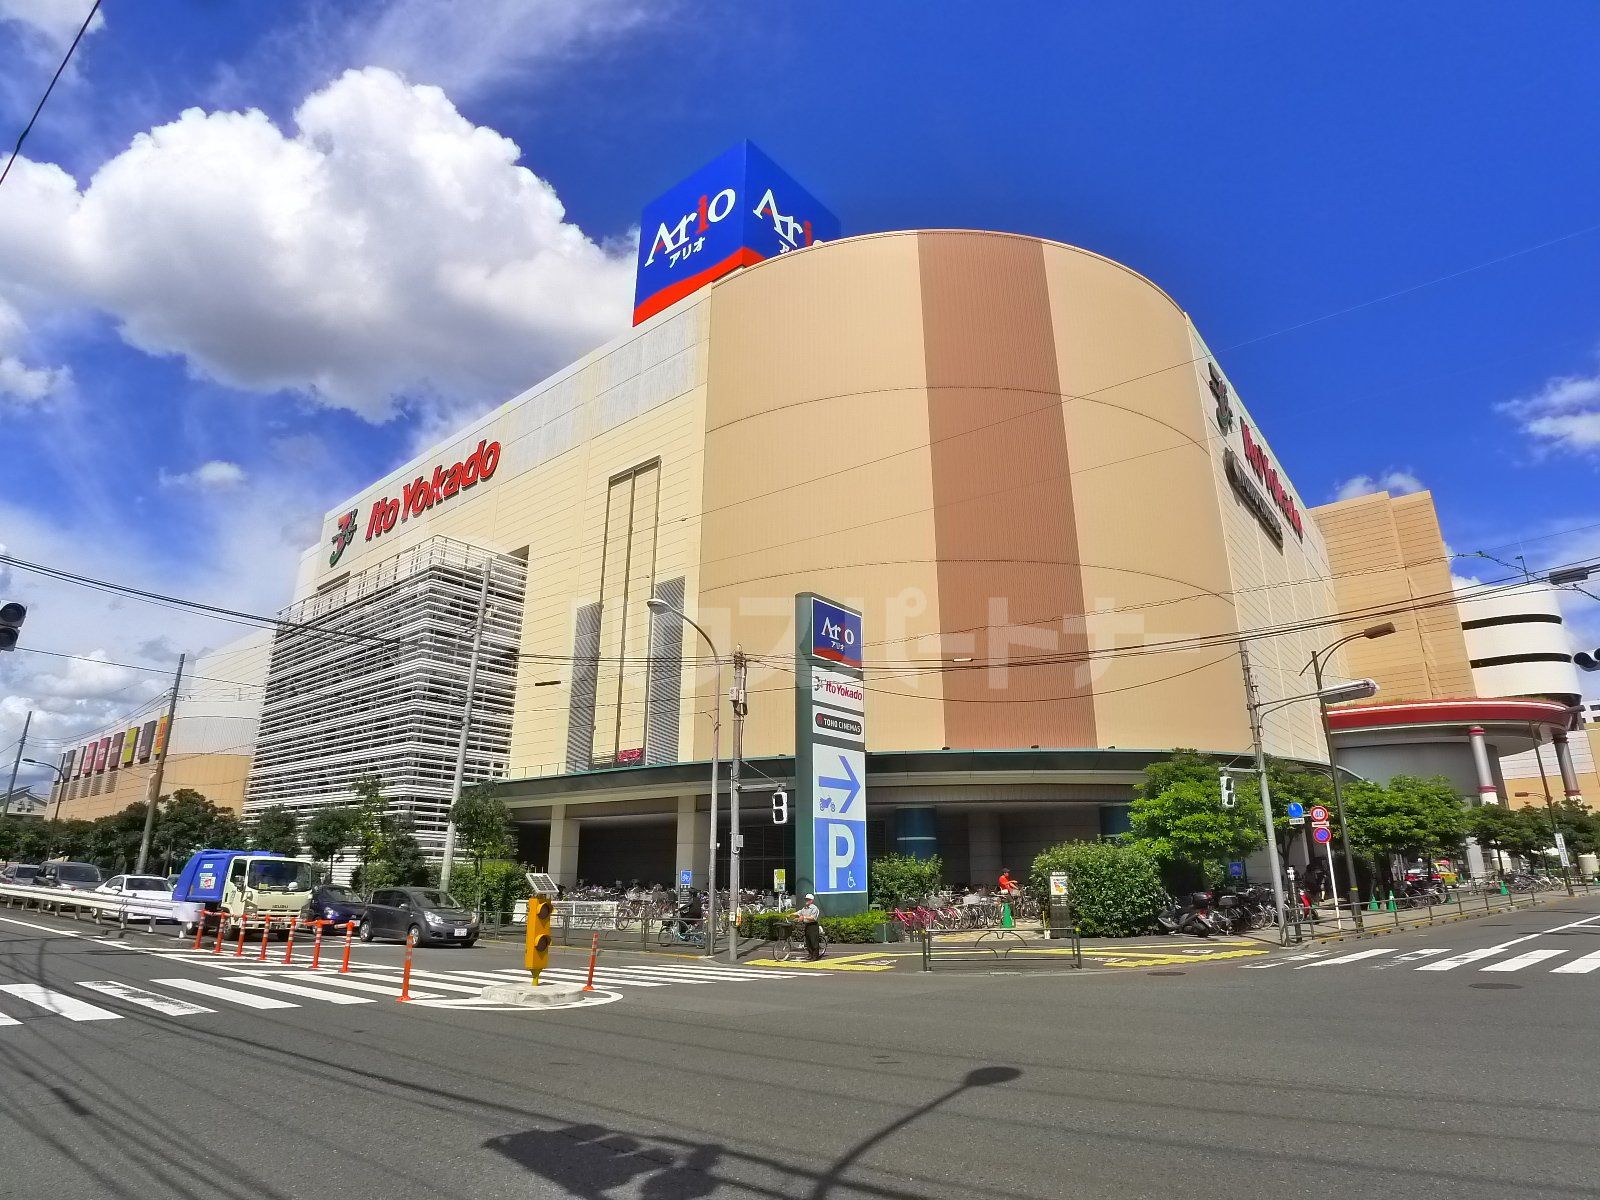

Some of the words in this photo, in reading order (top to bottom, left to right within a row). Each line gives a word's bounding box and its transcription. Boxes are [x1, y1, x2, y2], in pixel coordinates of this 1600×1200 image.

[644, 188, 736, 267] Ario
[753, 188, 823, 249] Ari
[669, 236, 706, 268] アリオ
[365, 496, 400, 541] Ito
[401, 439, 501, 524] Yokado
[821, 616, 855, 645] Ario
[826, 680, 836, 694] Ito
[837, 684, 863, 701] Yokado
[823, 717, 838, 728] TOHO
[838, 720, 861, 733] CINEMAS
[828, 823, 855, 889] P
